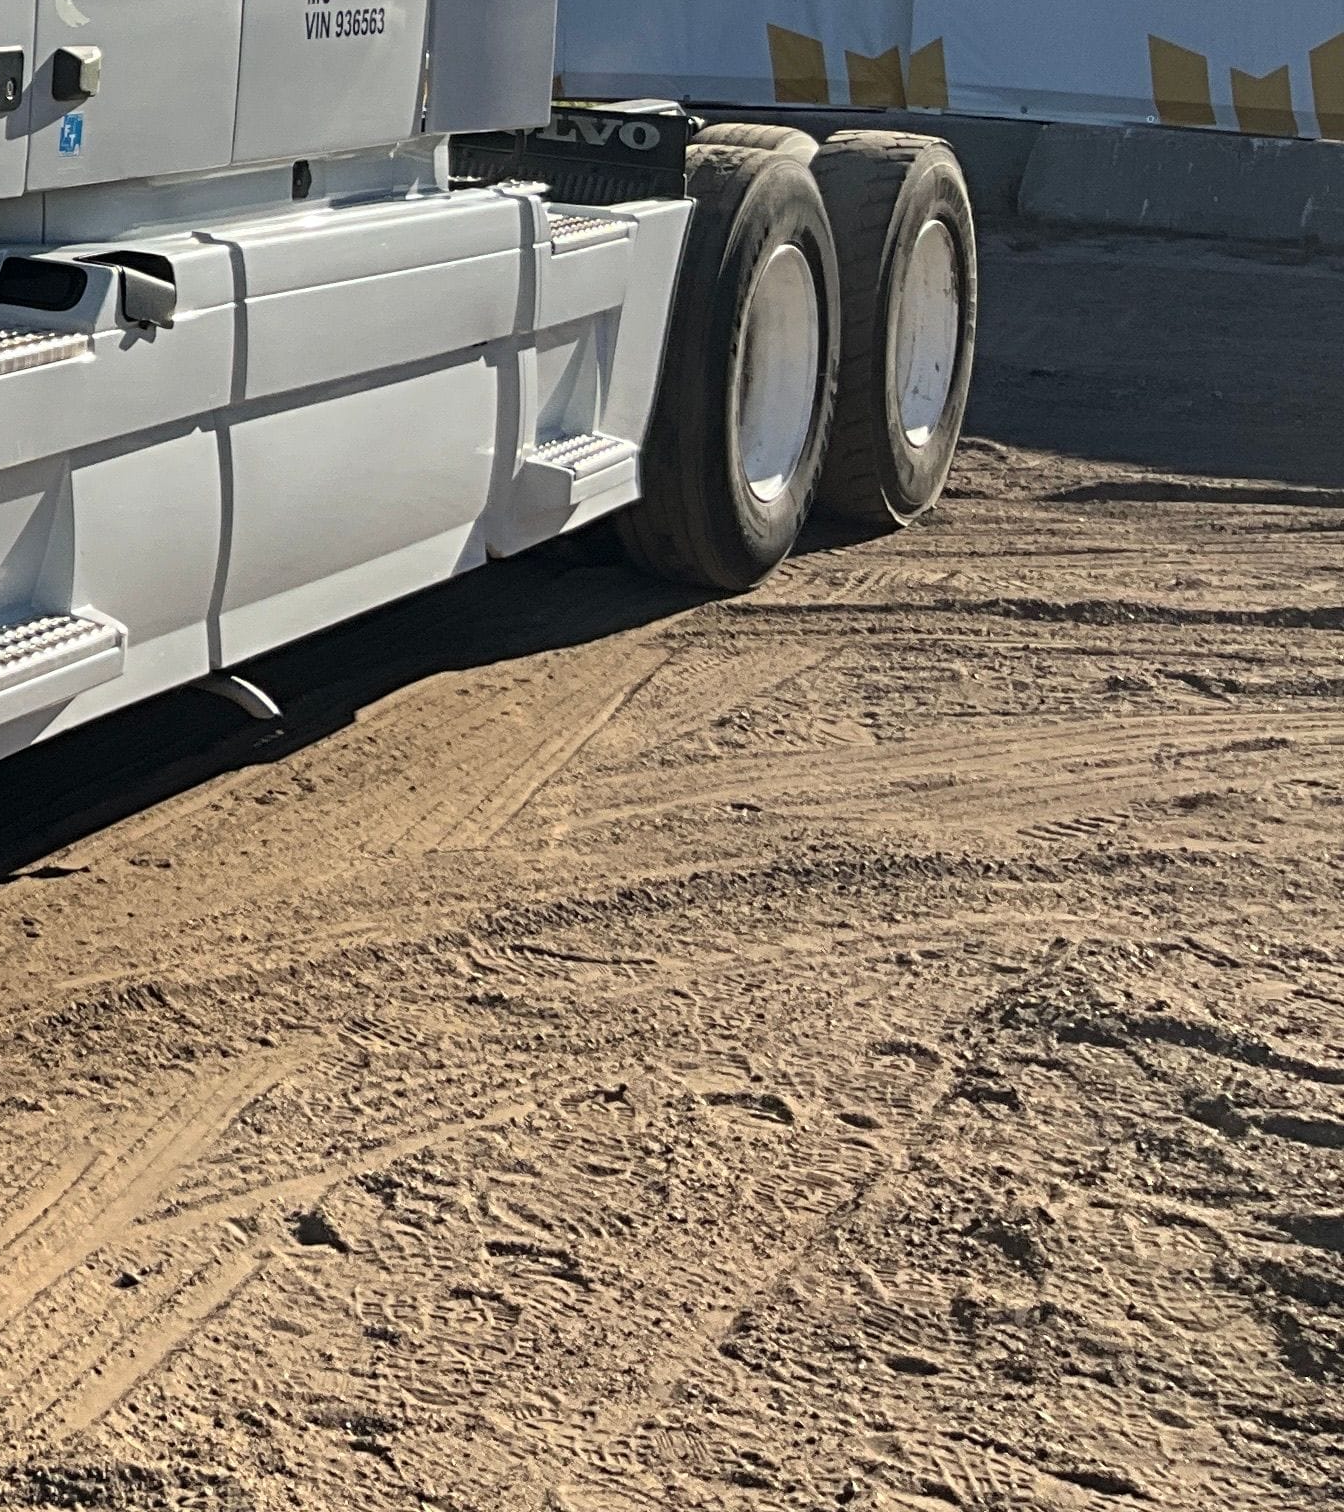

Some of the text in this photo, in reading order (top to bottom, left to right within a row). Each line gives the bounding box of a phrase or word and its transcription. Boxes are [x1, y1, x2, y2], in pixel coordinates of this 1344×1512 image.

[305, 7, 386, 40] VIN 936563
[502, 113, 661, 151] LVO
